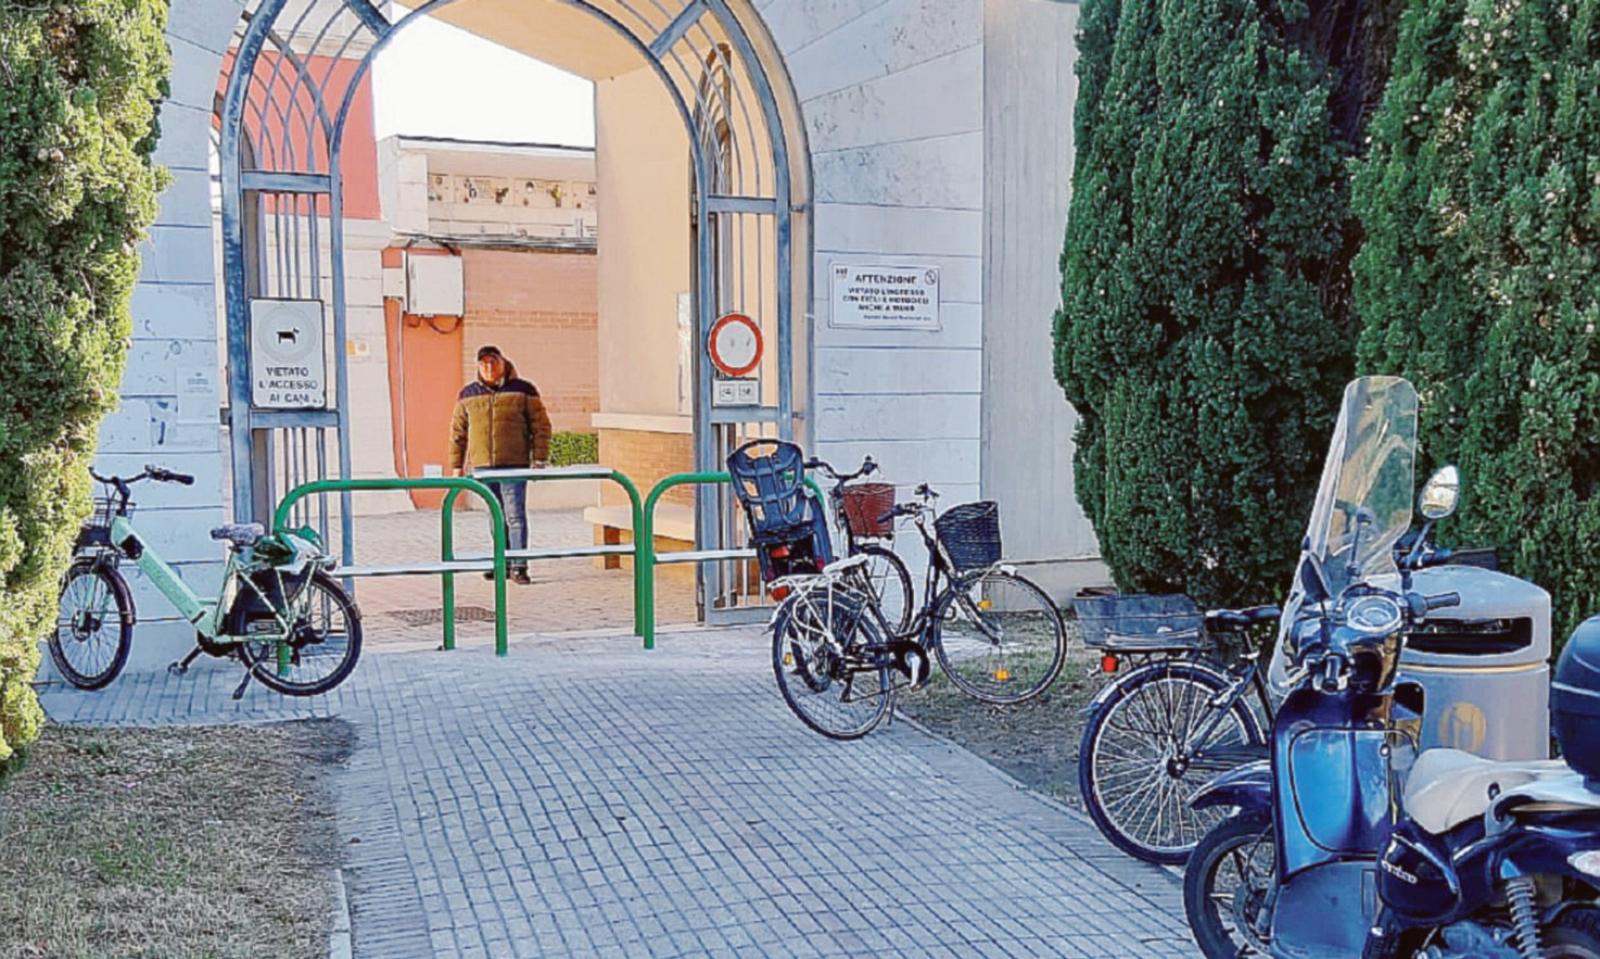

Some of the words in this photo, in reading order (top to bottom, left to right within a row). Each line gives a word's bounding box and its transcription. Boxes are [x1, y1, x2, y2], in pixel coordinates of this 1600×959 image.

[855, 274, 917, 285] ATTENZIONE
[266, 367, 309, 377] VIETATO
[258, 380, 318, 390] L'ACCESSO
[269, 393, 280, 402] AI
[284, 393, 310, 403] CANI
